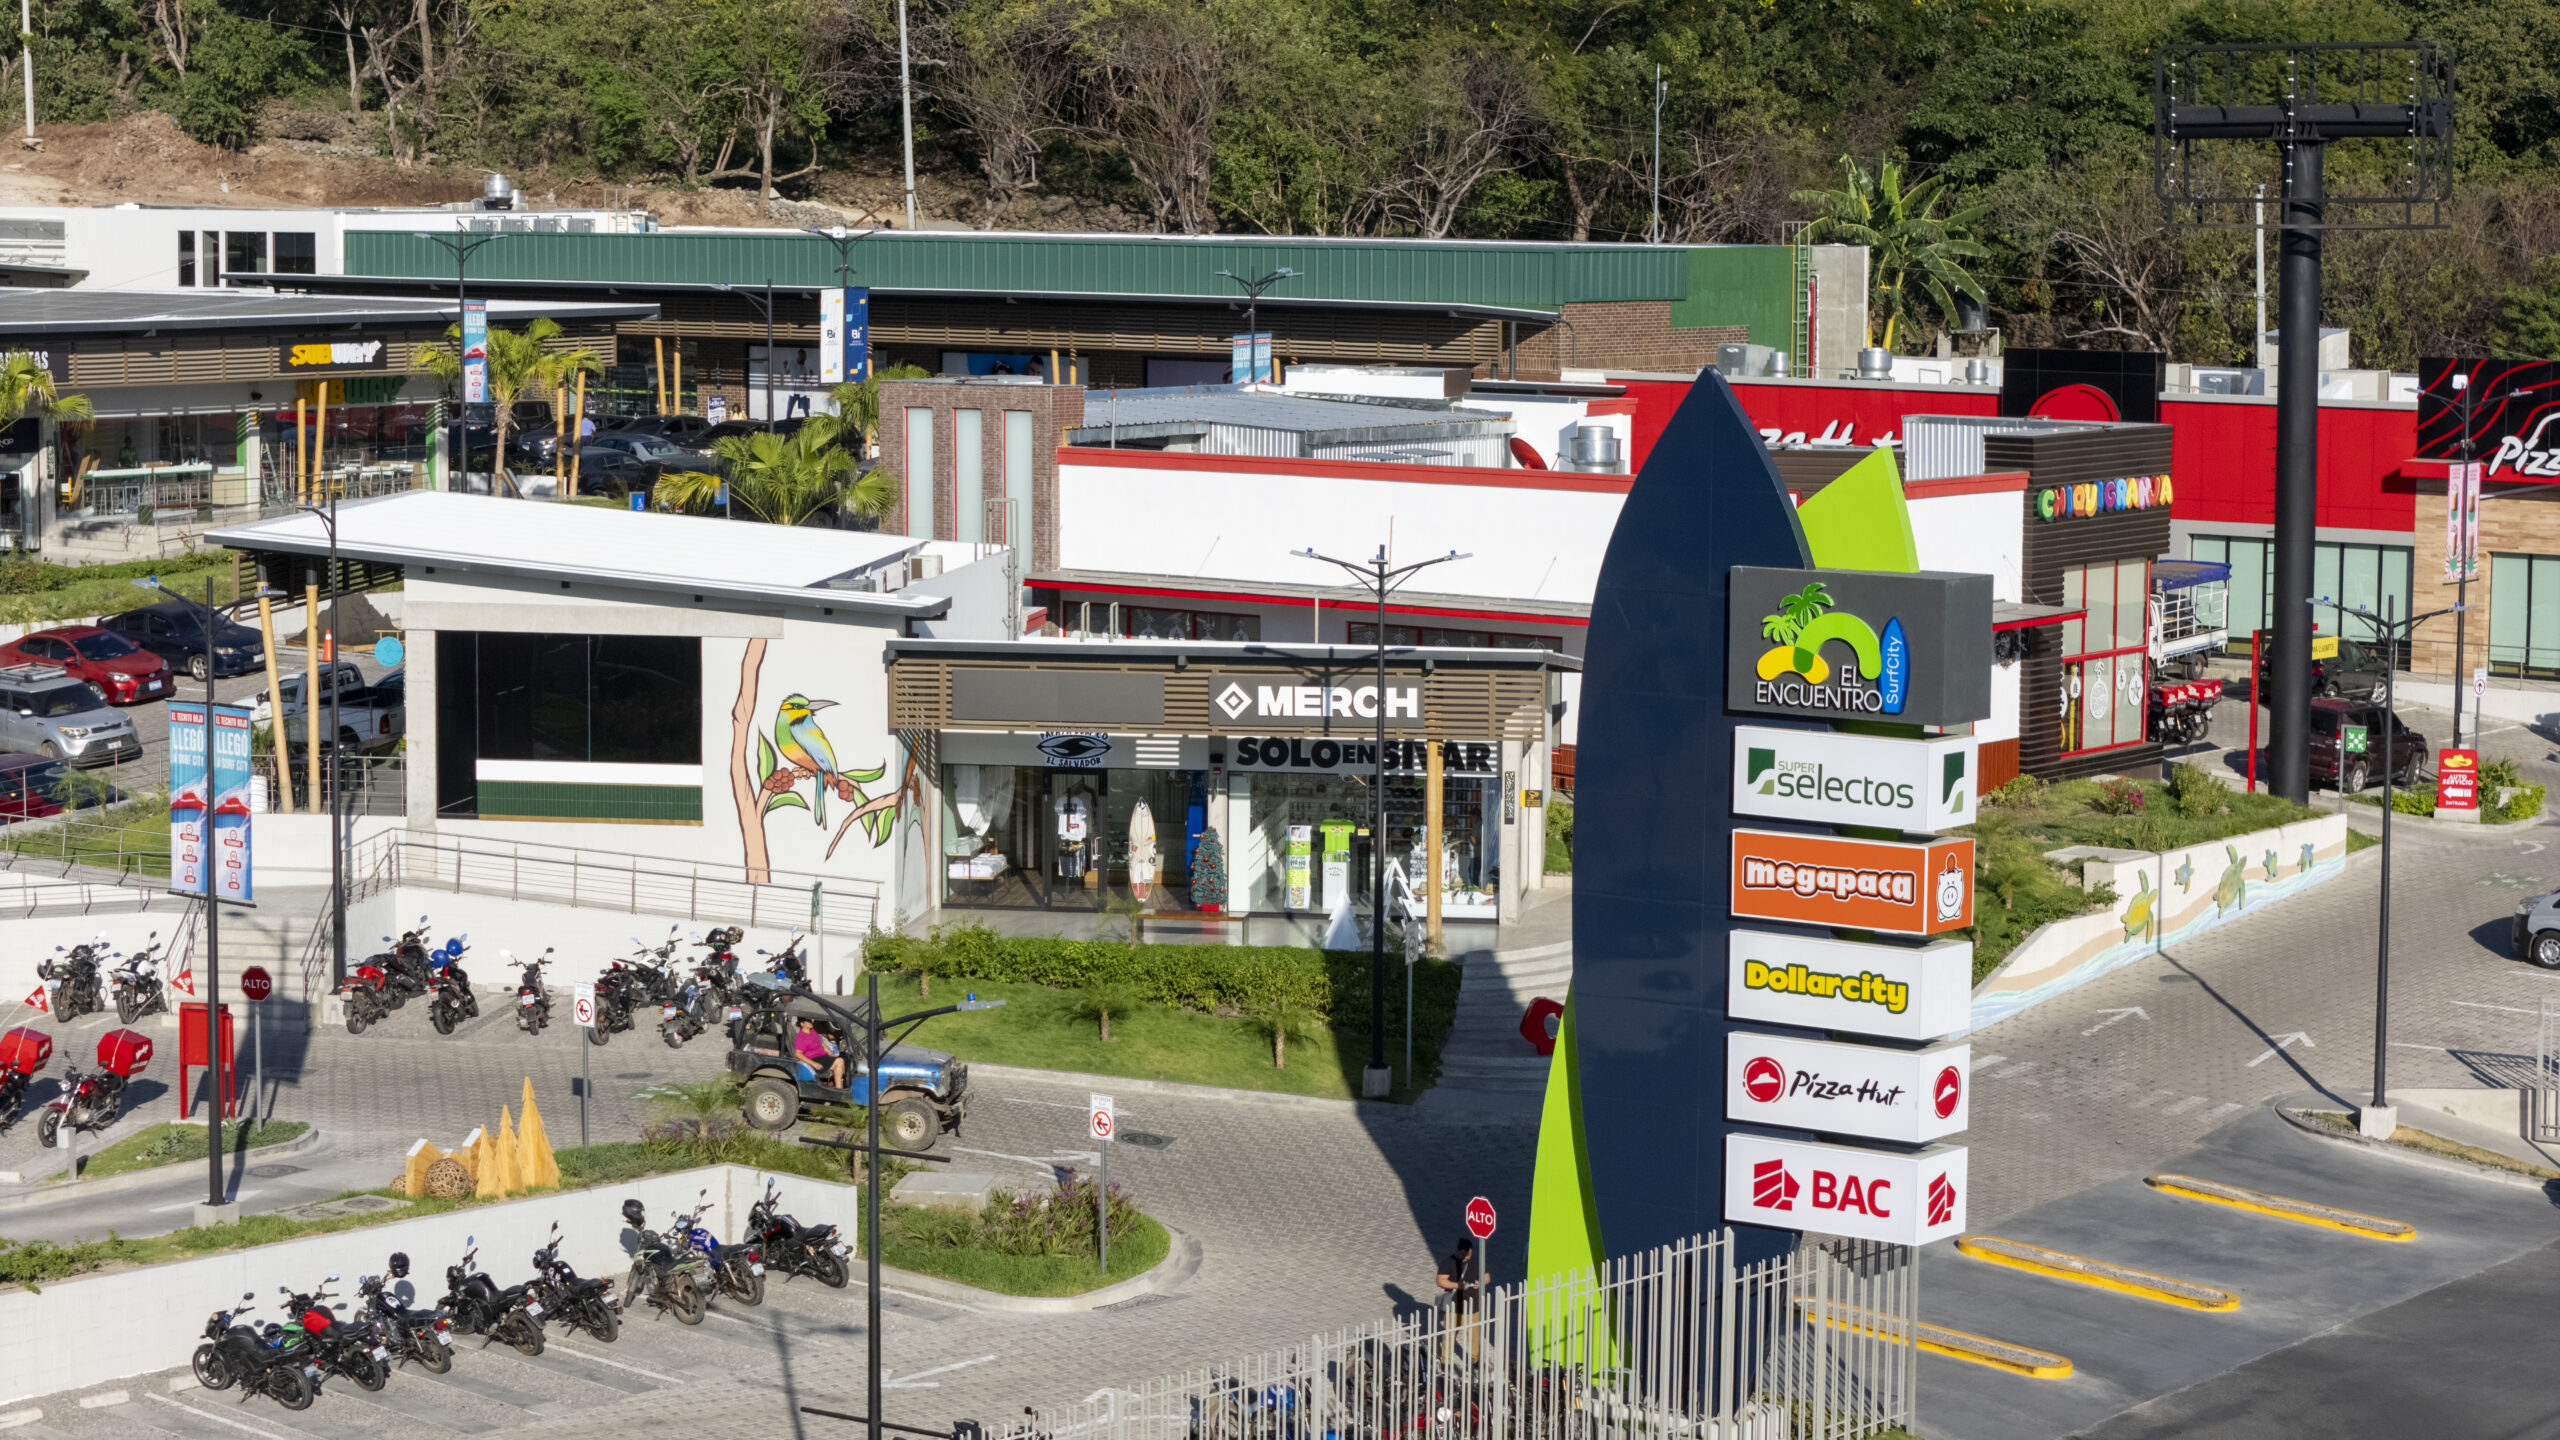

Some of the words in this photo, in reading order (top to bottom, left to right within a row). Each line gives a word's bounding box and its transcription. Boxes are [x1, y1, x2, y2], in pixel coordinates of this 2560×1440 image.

[288, 340, 382, 367] SUBWAY
[2037, 474, 2174, 522] CHIQUIGRANJA
[1841, 665, 1862, 687] EL
[1886, 636, 1903, 705] SurfCity
[1257, 686, 1418, 718] MERCH
[1756, 681, 1883, 712] ENCUENTRO
[172, 726, 204, 752] LLEGÓ
[216, 730, 249, 757] LLEGÓ
[1236, 737, 1341, 768] SOLO
[1046, 756, 1055, 765] EL
[1059, 757, 1101, 768] SALVADOR
[1778, 761, 1815, 773] SUPER
[1777, 763, 1914, 809] selectos
[1746, 860, 1914, 902] megapaca
[243, 978, 270, 990] ALTO
[1746, 961, 1908, 1013] Dollarcity
[1789, 1070, 1852, 1100] Pizza
[1857, 1078, 1906, 1106] Hut
[1811, 1170, 1891, 1218] BAC
[1468, 1211, 1493, 1225] ALTO
